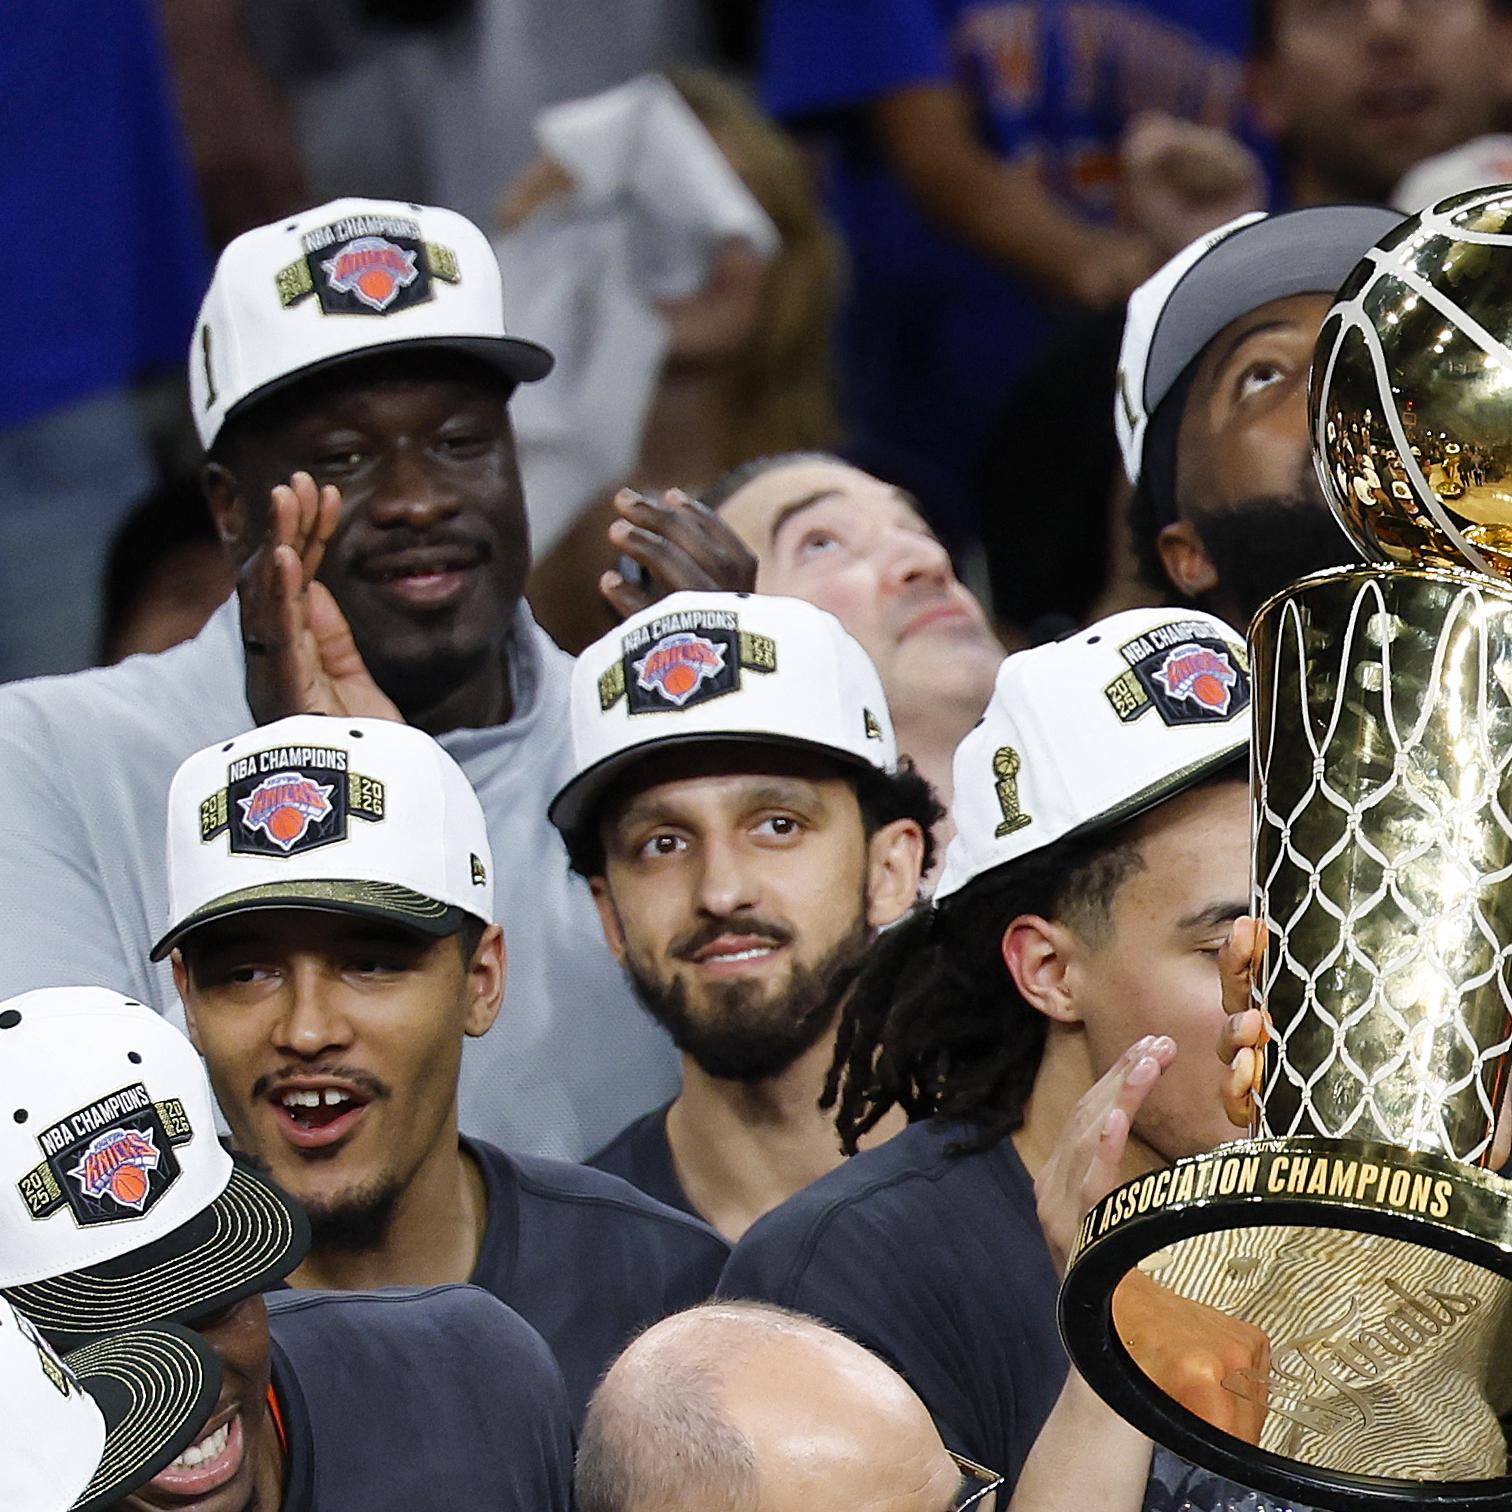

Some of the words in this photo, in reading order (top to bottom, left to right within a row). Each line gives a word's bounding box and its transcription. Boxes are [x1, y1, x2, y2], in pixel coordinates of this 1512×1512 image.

[650, 611, 738, 640] CHAMPIONS
[1120, 638, 1156, 666] NBA
[1106, 678, 1128, 700] 20
[1116, 696, 1138, 718] 25
[230, 758, 257, 782] NBA
[260, 748, 347, 773] CHAMPIONS
[361, 778, 382, 799] 20
[201, 796, 217, 817] 20
[362, 795, 383, 815] 26
[202, 815, 218, 834] 25
[40, 1125, 75, 1157] NBA
[70, 1084, 151, 1131] CHAMPIONS
[165, 1100, 183, 1118] 20
[171, 1116, 190, 1135] 26
[85, 1132, 158, 1193] KNICKS
[21, 1172, 42, 1198] 20
[1098, 1157, 1260, 1236] ASSOCIATION
[1267, 1157, 1453, 1219] CHAMPIONS
[28, 1189, 50, 1214] 25
